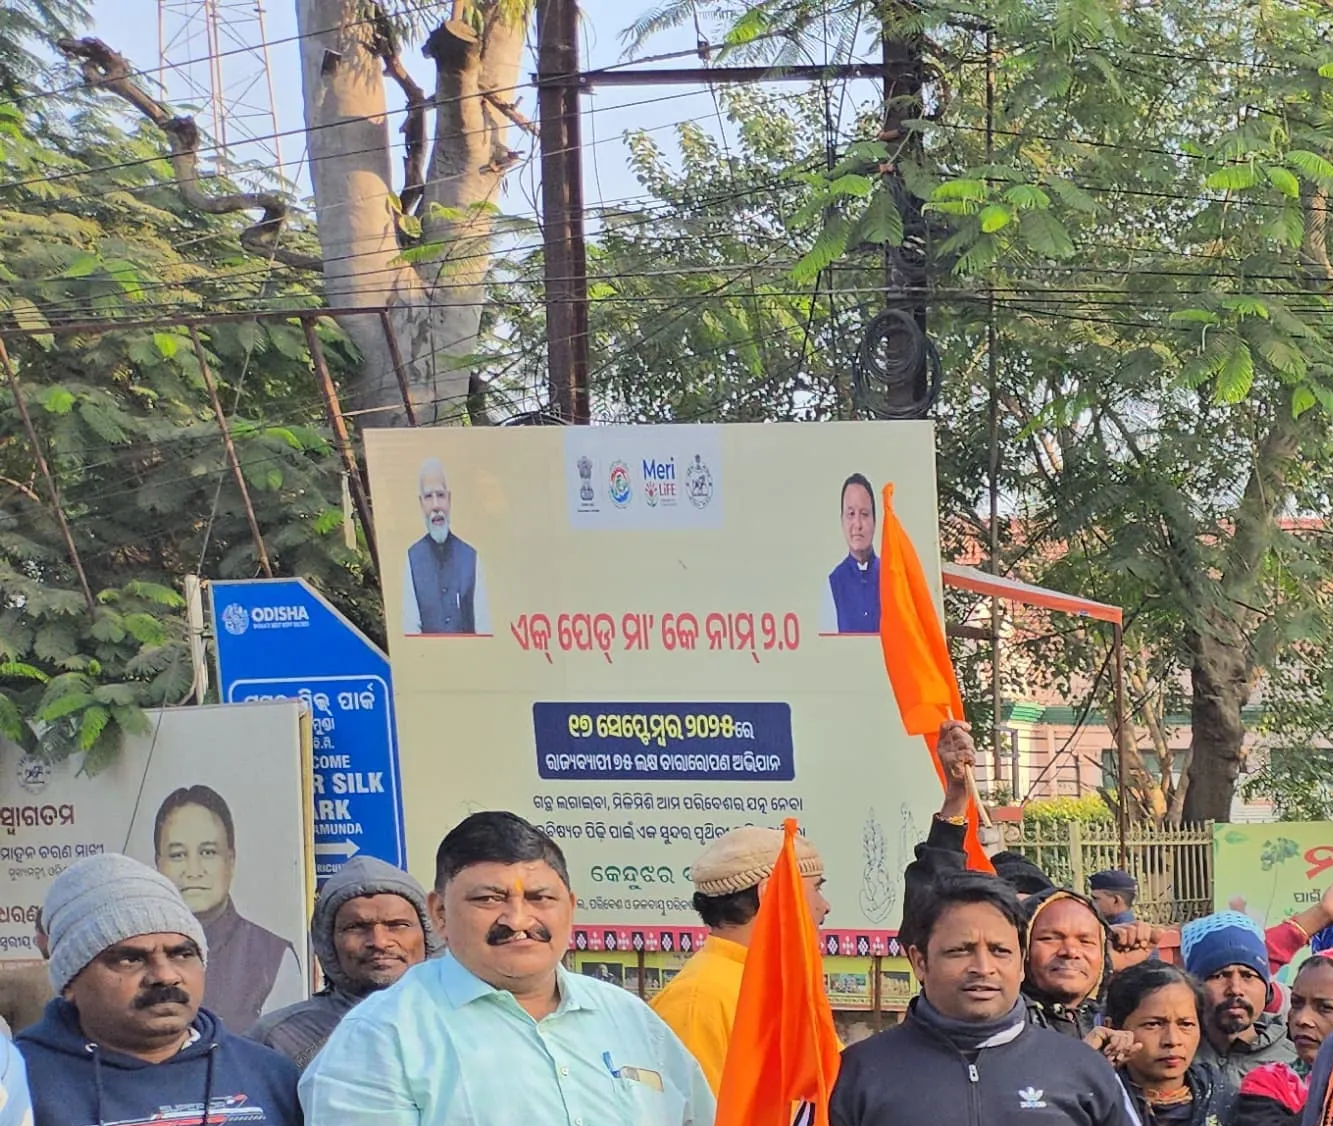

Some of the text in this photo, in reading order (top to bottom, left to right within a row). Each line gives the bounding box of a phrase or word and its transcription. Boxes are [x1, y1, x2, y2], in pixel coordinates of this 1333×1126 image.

[642, 456, 676, 480] Meri
[658, 482, 677, 497] LiFE
[251, 605, 310, 623] ODISHA
[661, 612, 699, 651] କେ
[705, 612, 760, 663] ନାମ୍
[337, 682, 376, 710] ପାର୍କ
[568, 714, 593, 738] ୧୭
[312, 754, 351, 769] COME
[332, 772, 385, 794] SILK
[656, 795, 682, 811] ଆମ
[770, 795, 803, 812] ନେବା
[636, 825, 657, 840] ଏକ
[591, 865, 675, 890] କେନ୍ଦୁଝର
